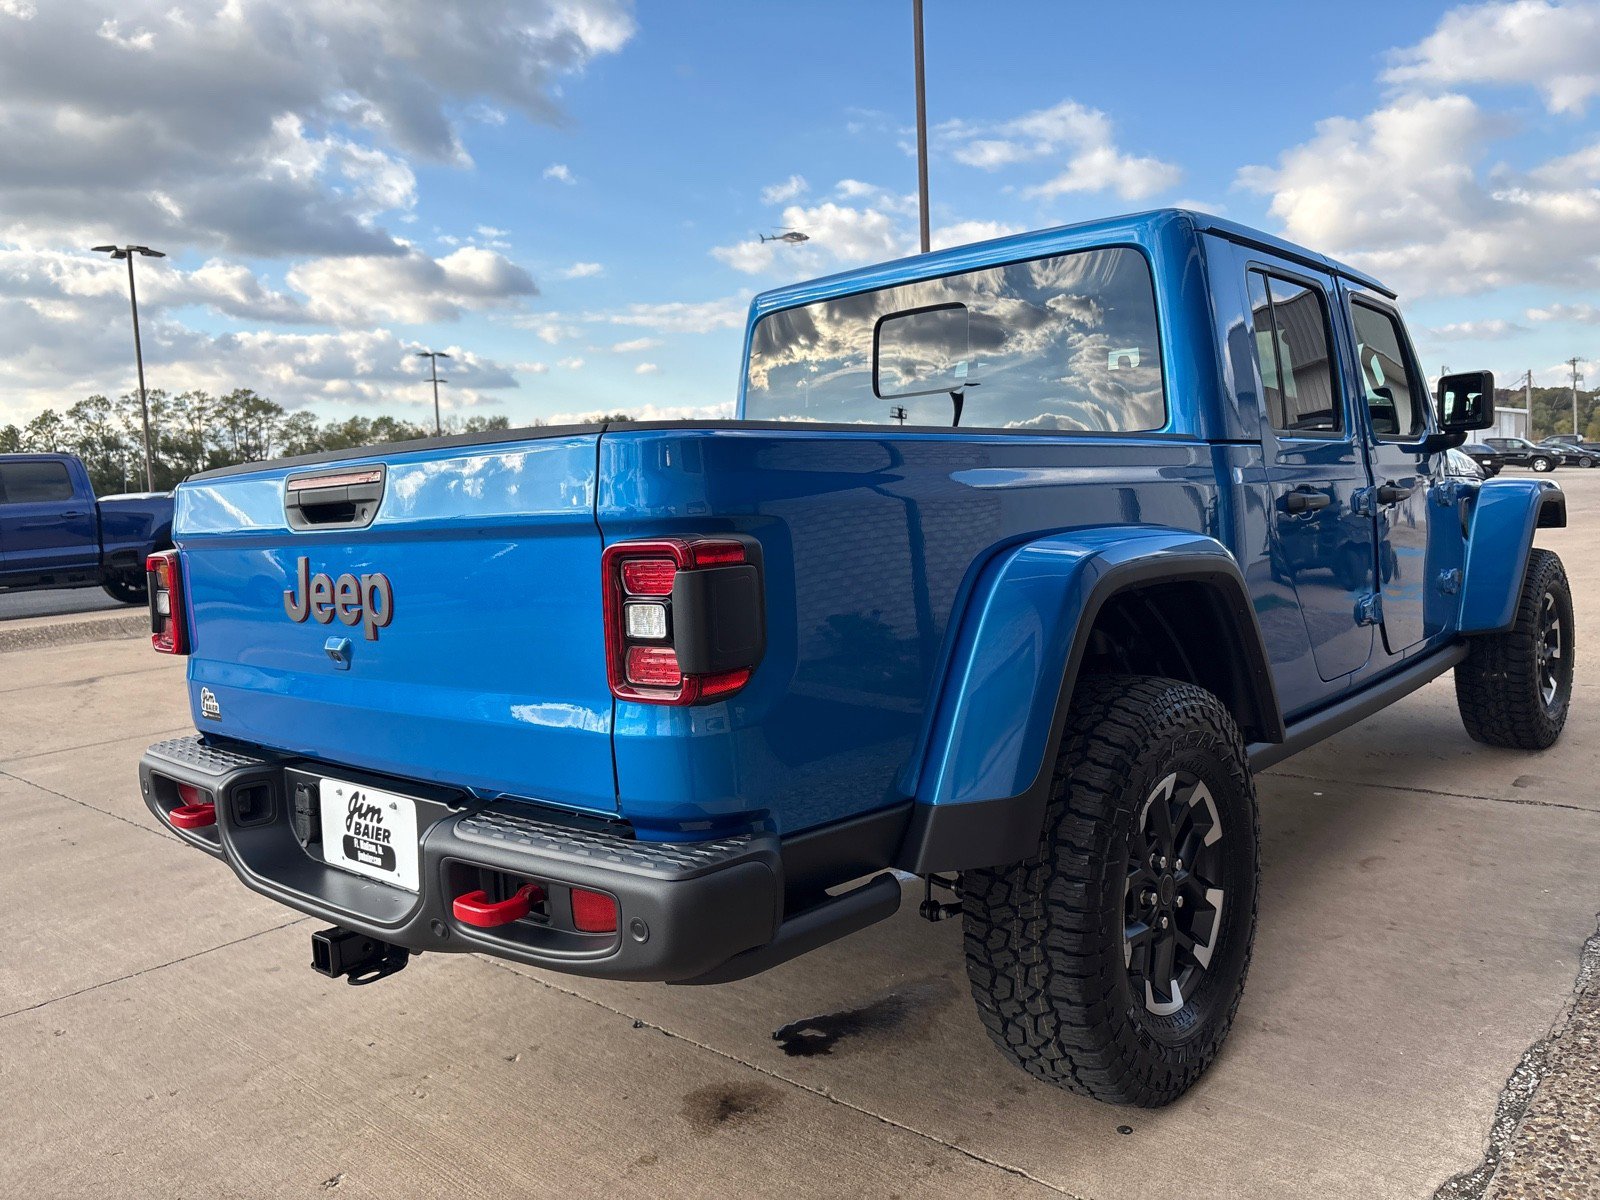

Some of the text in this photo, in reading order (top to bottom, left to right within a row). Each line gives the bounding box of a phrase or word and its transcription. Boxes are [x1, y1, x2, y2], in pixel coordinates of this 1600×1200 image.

[283, 557, 394, 641] Jeep
[345, 791, 383, 832] Jim
[354, 821, 391, 844] BAIER
